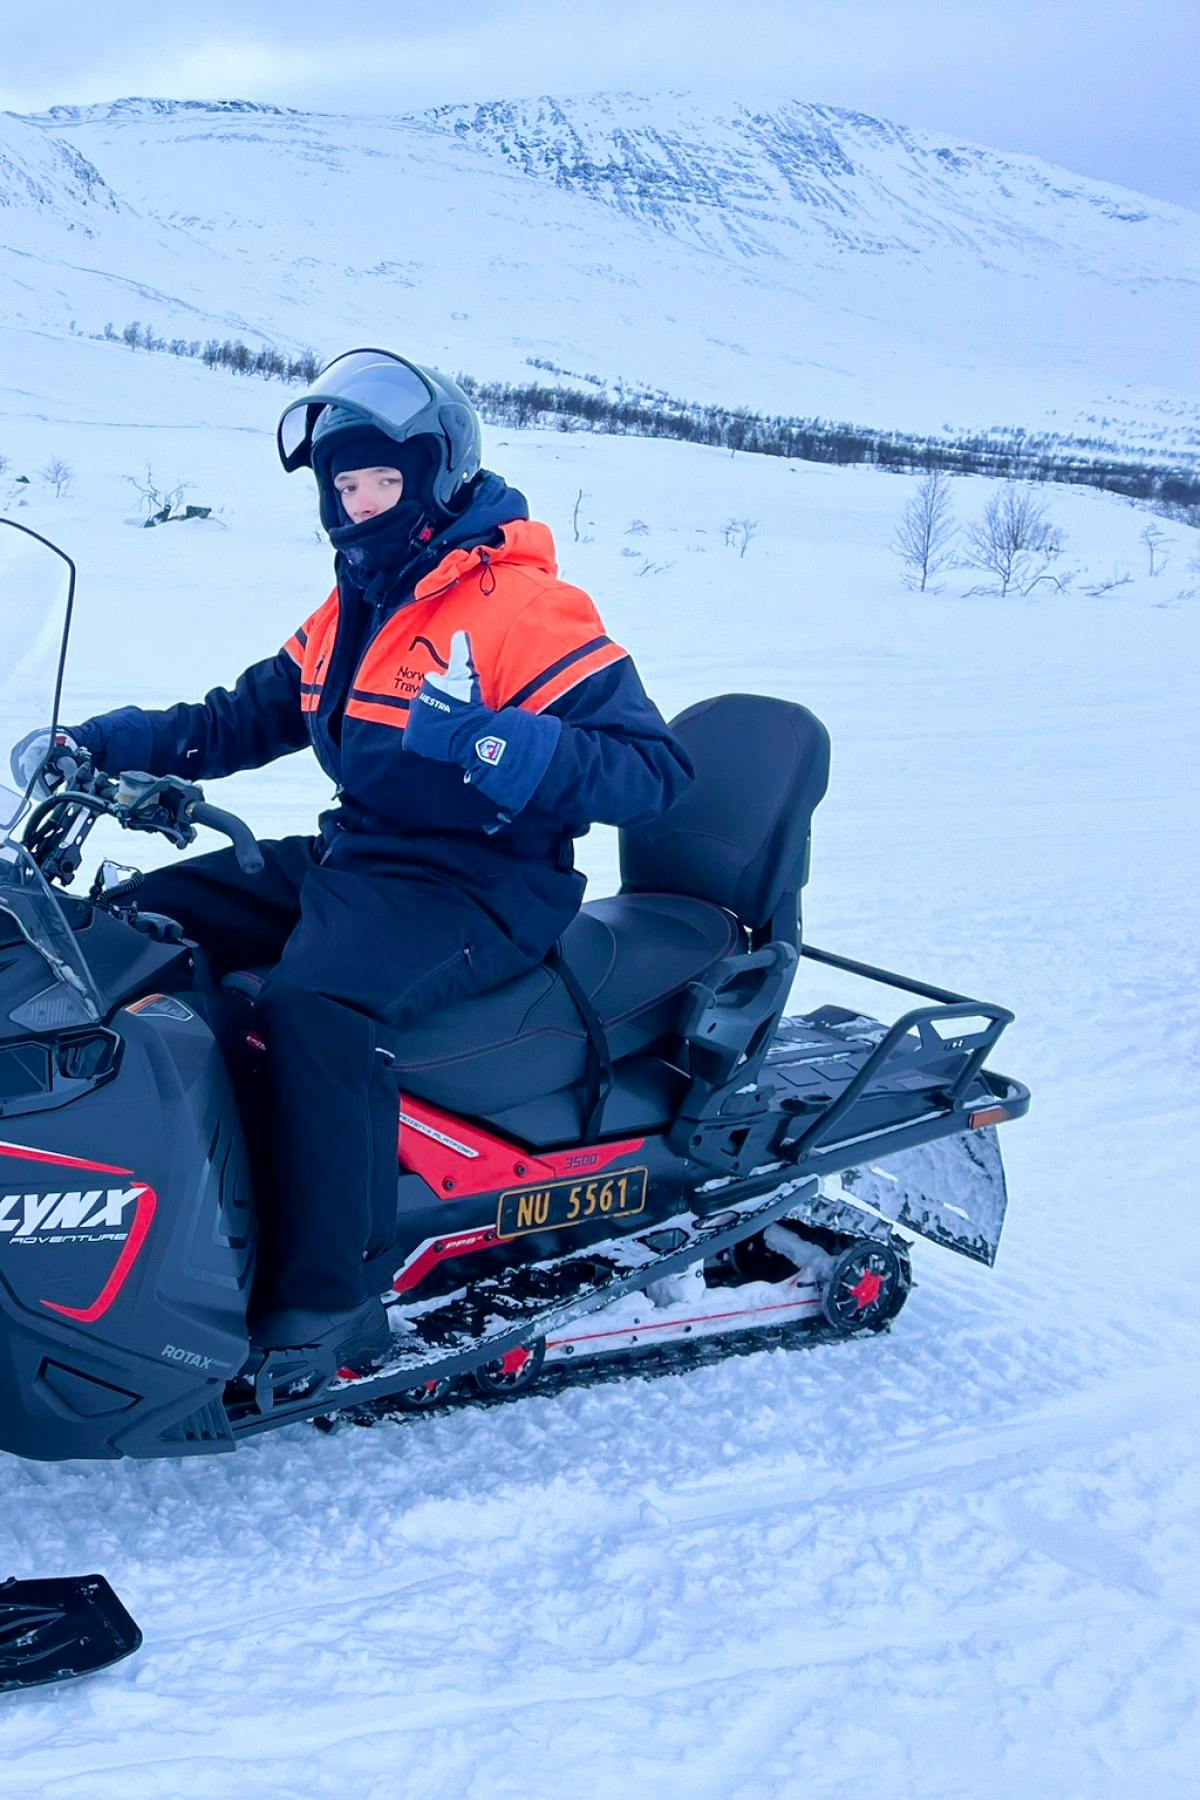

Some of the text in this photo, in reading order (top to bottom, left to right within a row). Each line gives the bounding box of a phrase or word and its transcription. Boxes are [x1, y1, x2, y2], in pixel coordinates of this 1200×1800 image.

[394, 677, 420, 694] Trav
[419, 692, 451, 713] HESTRA
[564, 1153, 598, 1170] 3500
[516, 1177, 628, 1228] NU 5561
[9, 1232, 129, 1246] ADVENTURE
[161, 1344, 213, 1370] ROTAX
